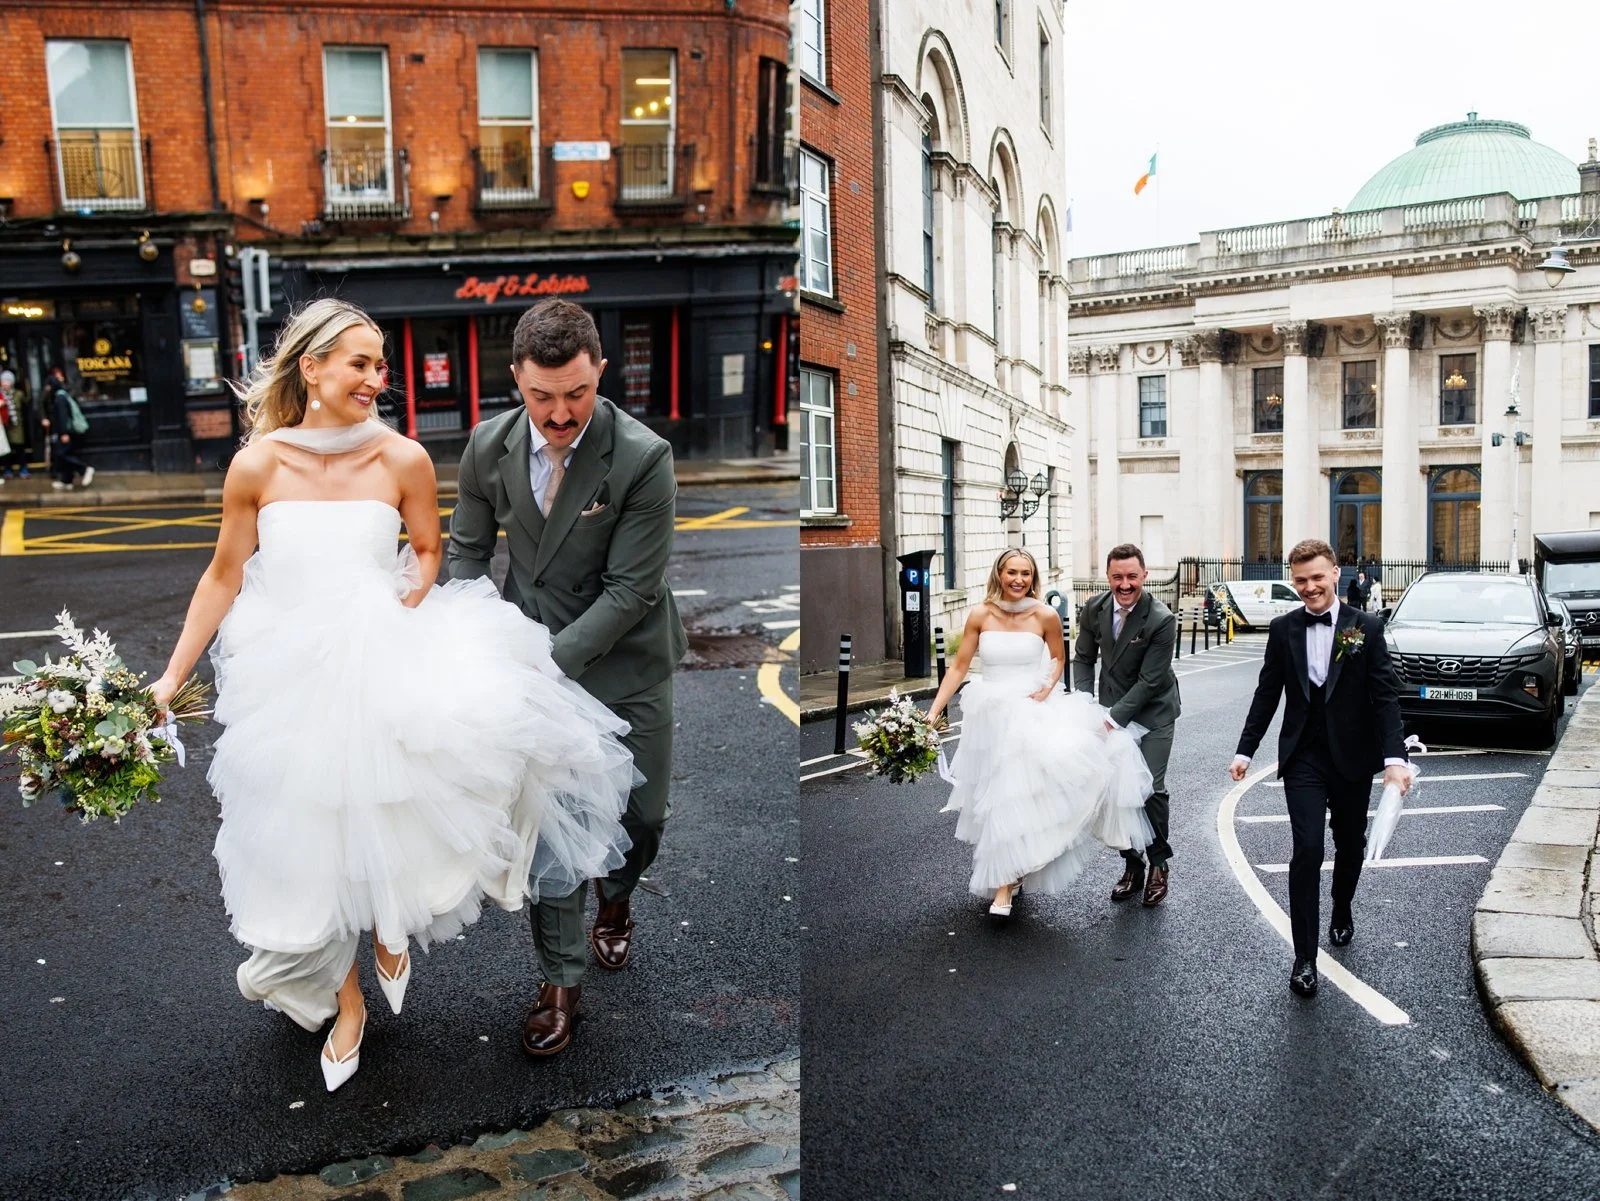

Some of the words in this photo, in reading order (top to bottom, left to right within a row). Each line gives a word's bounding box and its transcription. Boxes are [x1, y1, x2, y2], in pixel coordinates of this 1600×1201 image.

[504, 275, 519, 296] &
[77, 356, 132, 371] TOSCANA
[909, 570, 918, 582] P
[923, 572, 929, 584] P
[1429, 690, 1473, 700] 221-MH-1099
